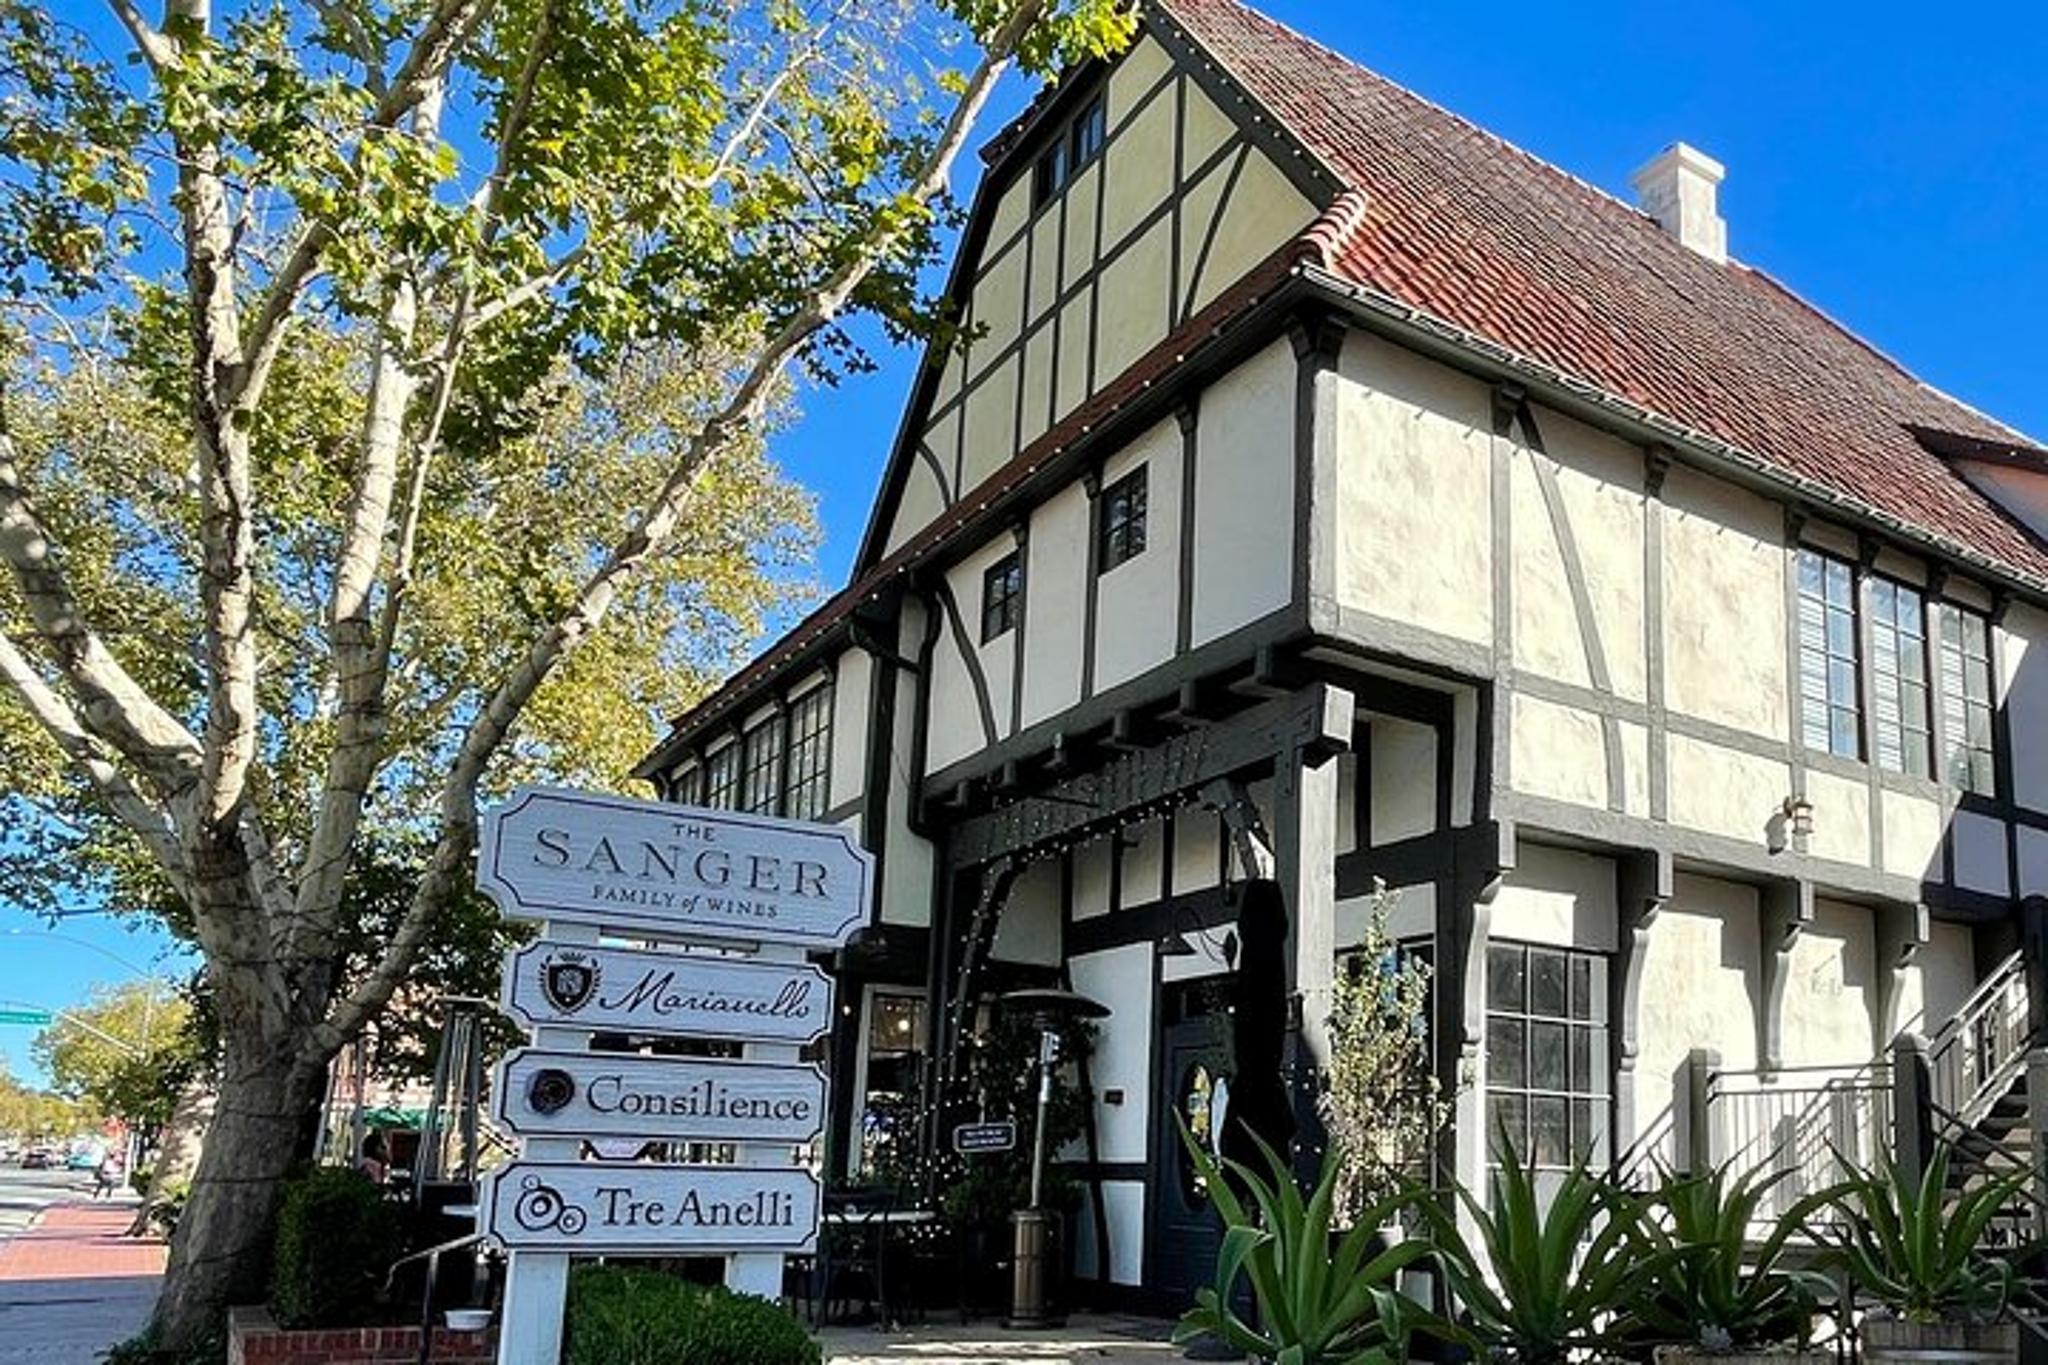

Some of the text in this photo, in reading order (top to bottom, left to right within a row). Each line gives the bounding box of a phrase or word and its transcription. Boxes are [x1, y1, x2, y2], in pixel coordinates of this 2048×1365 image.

[673, 822, 717, 842] THE
[533, 828, 831, 900] SANGER
[592, 885, 779, 919] FAMILY of WINES
[600, 969, 811, 1018] Marianello
[587, 1074, 810, 1121] Consilience
[594, 1187, 795, 1227] Tre Anelli
